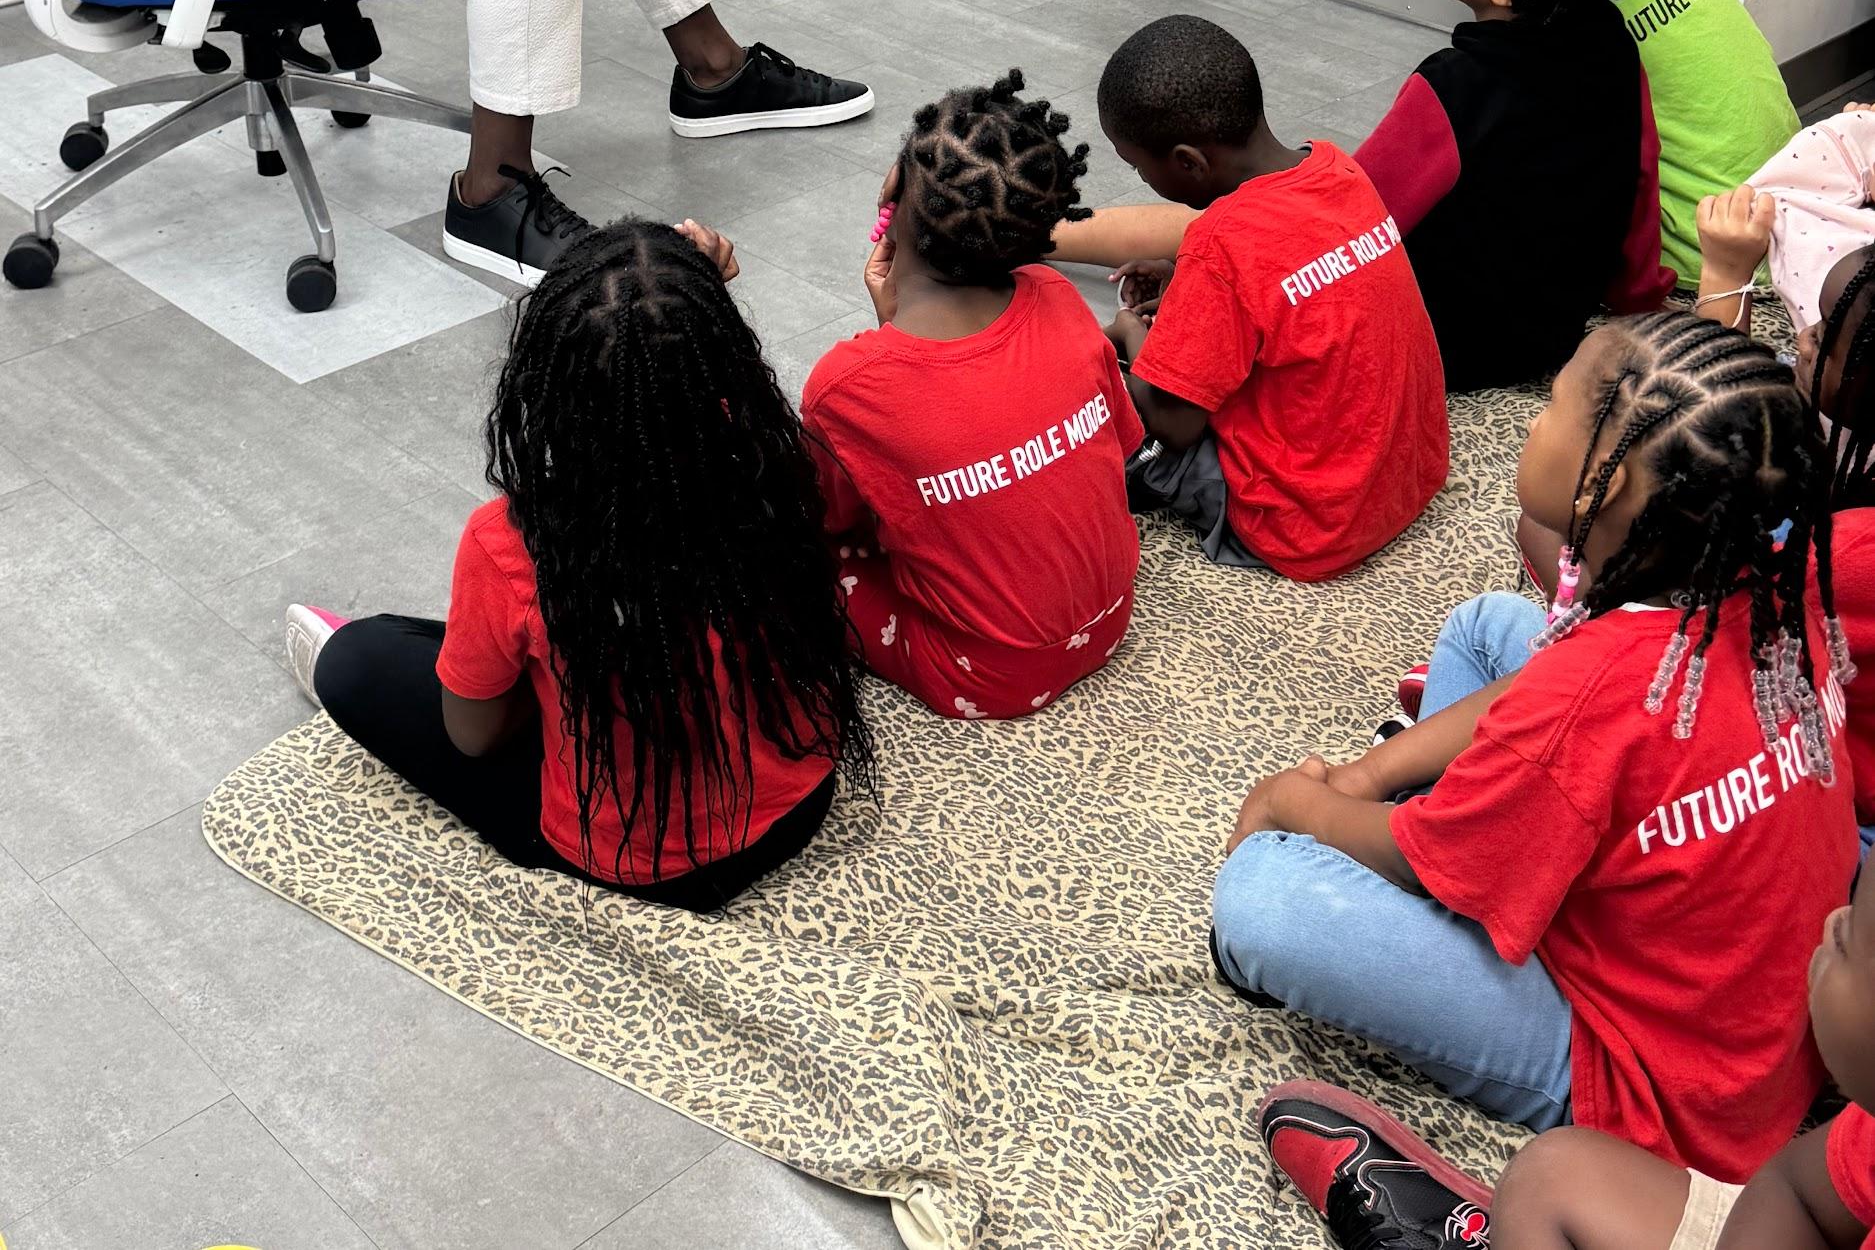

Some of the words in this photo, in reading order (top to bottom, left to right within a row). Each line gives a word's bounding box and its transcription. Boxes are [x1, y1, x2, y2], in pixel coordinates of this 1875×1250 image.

[1280, 247, 1358, 307] FUTURE
[1347, 224, 1393, 268] ROLE
[916, 453, 1012, 507] FUTURE
[1007, 424, 1065, 481] ROLE
[1637, 751, 1776, 855] FUTURE
[1775, 723, 1812, 793] RO
